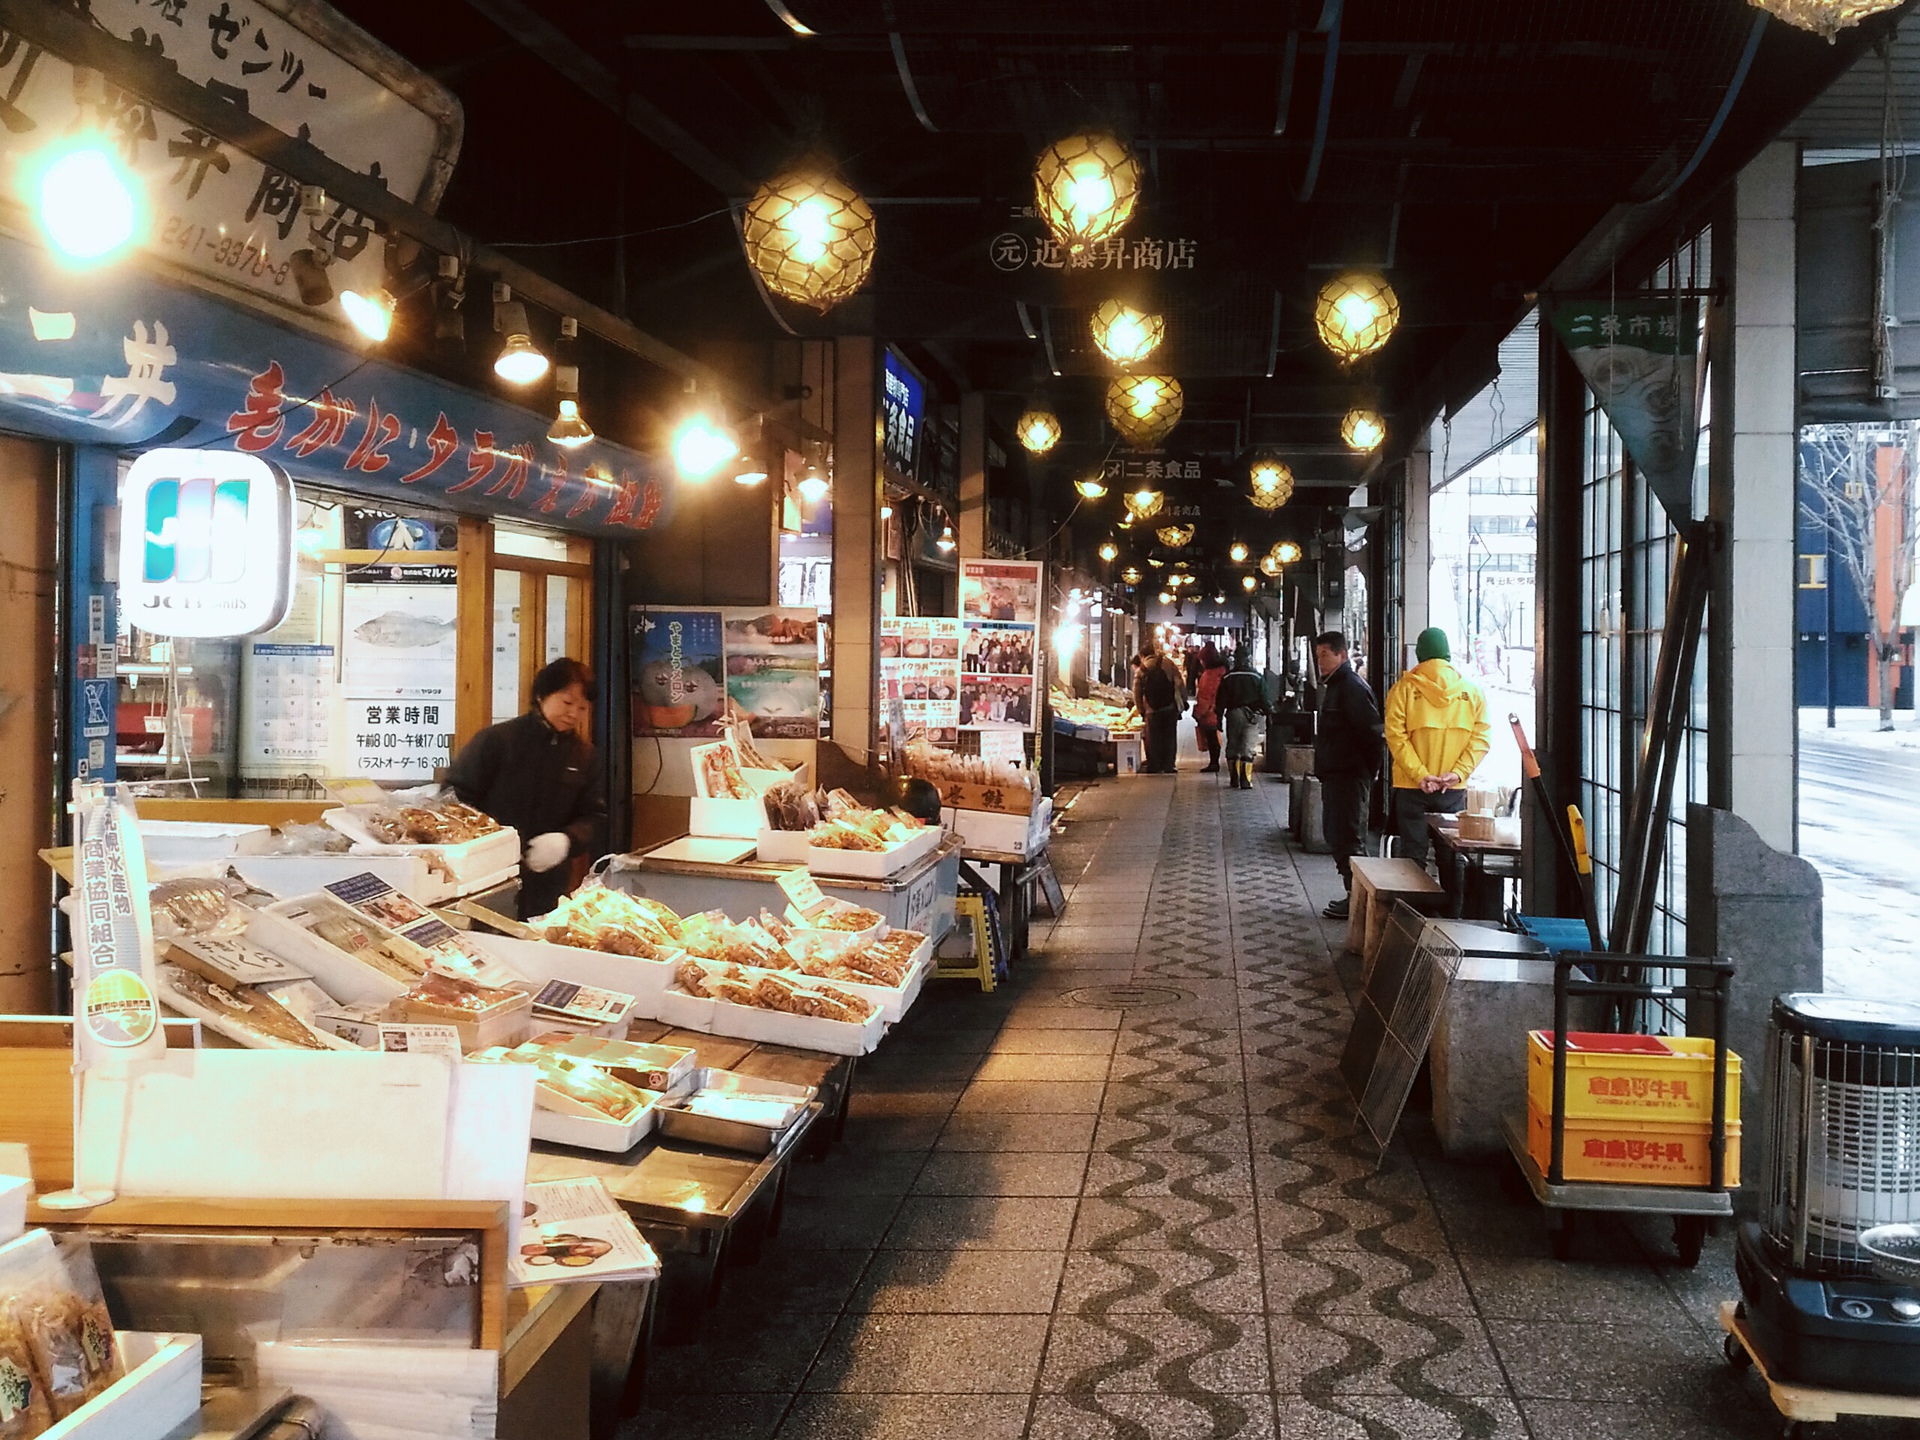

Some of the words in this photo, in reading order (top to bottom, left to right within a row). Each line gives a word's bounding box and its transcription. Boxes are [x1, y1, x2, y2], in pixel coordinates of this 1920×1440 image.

[208, 2, 327, 100] ゼンツー
[1571, 314, 1676, 337] 二条市場
[1126, 460, 1201, 479] 二条食品
[367, 705, 439, 725] 営業時間
[104, 812, 131, 915] 札幌水産物
[84, 838, 115, 966] 商業協同組合
